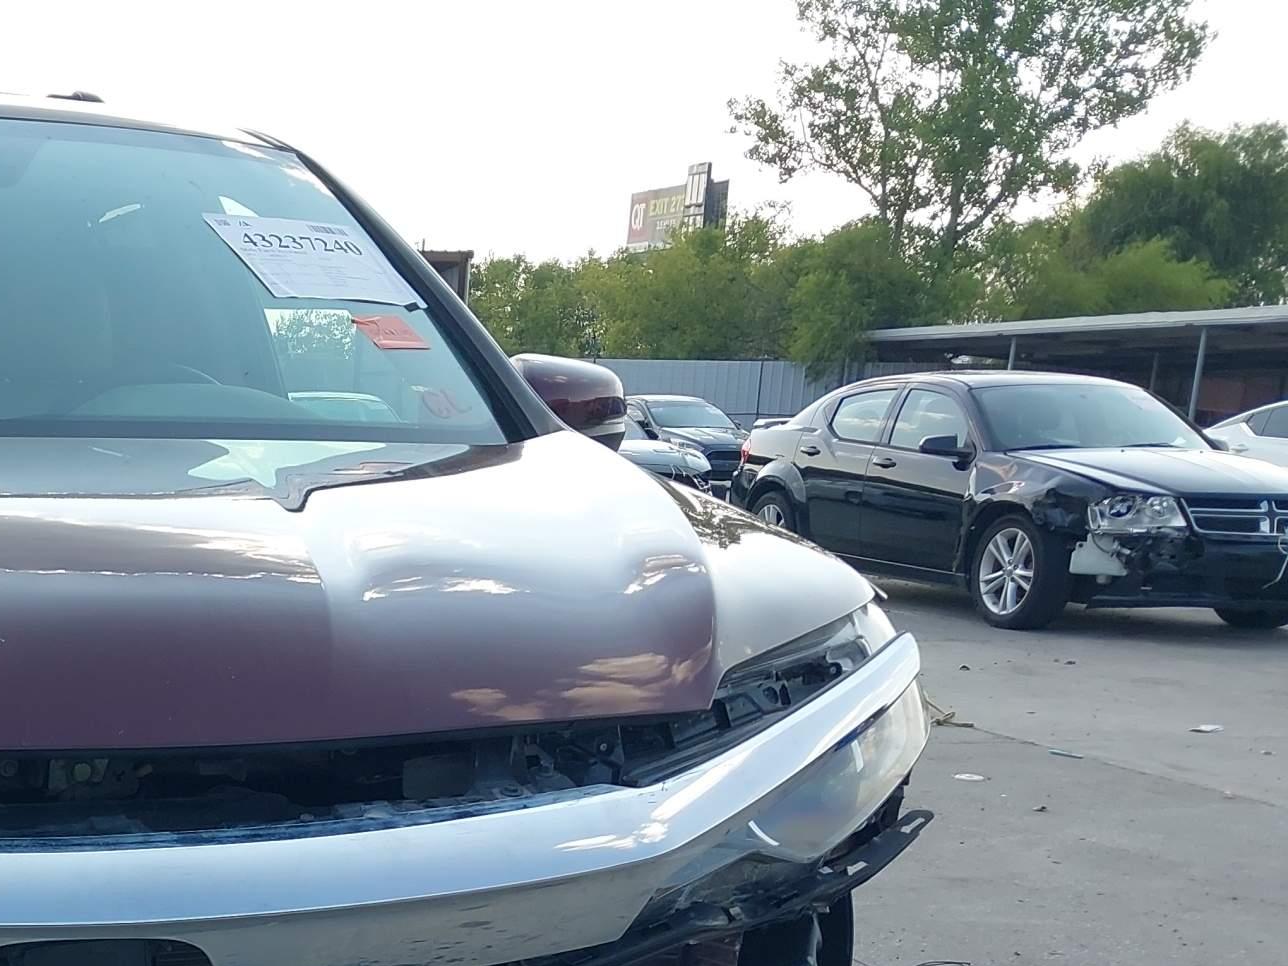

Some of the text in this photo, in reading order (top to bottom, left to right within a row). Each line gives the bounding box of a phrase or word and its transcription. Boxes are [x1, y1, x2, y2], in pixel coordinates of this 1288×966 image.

[632, 203, 646, 230] QT
[649, 198, 669, 216] EXIT
[242, 232, 363, 256] 43237240
